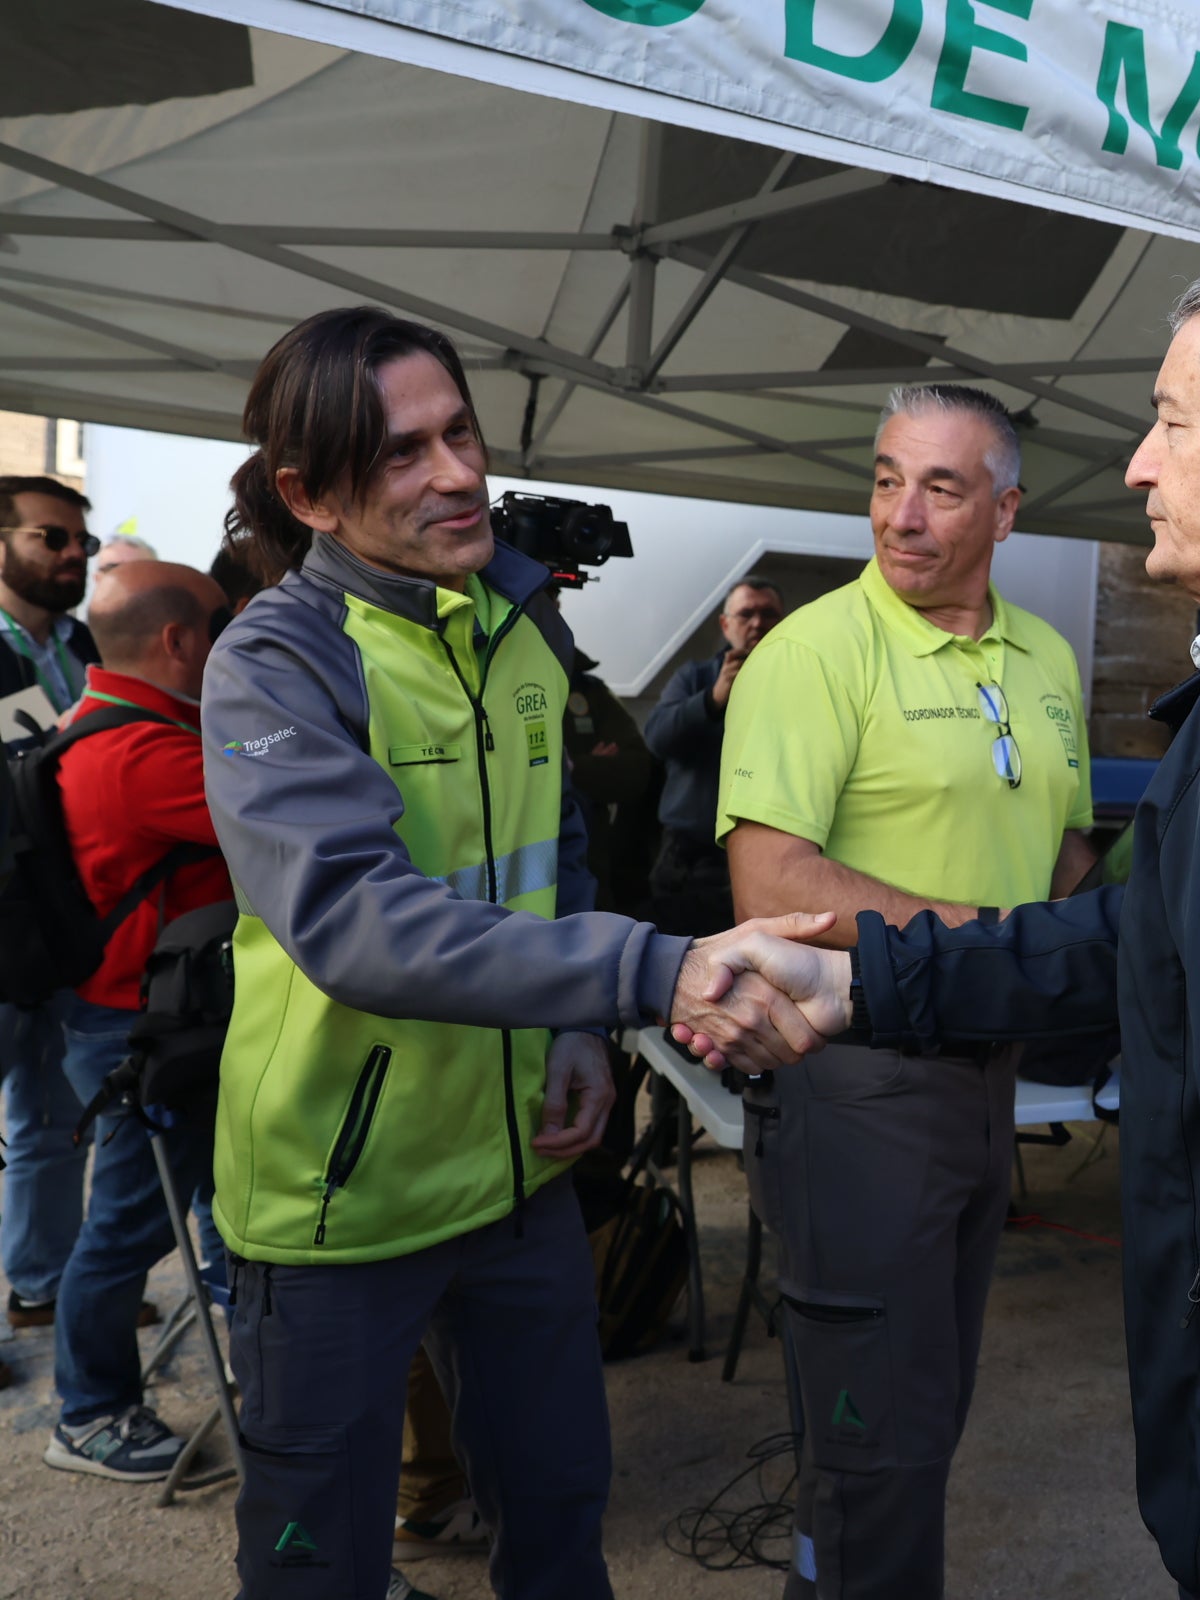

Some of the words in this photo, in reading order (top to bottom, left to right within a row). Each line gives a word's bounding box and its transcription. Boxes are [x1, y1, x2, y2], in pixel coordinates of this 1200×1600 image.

[784, 0, 1032, 131] DE
[516, 693, 548, 714] GREA
[903, 707, 956, 721] COORDINADOR
[1046, 705, 1071, 722] GREA
[243, 726, 297, 752] Tragsatec
[529, 730, 545, 744] 112
[734, 768, 755, 779] tec
